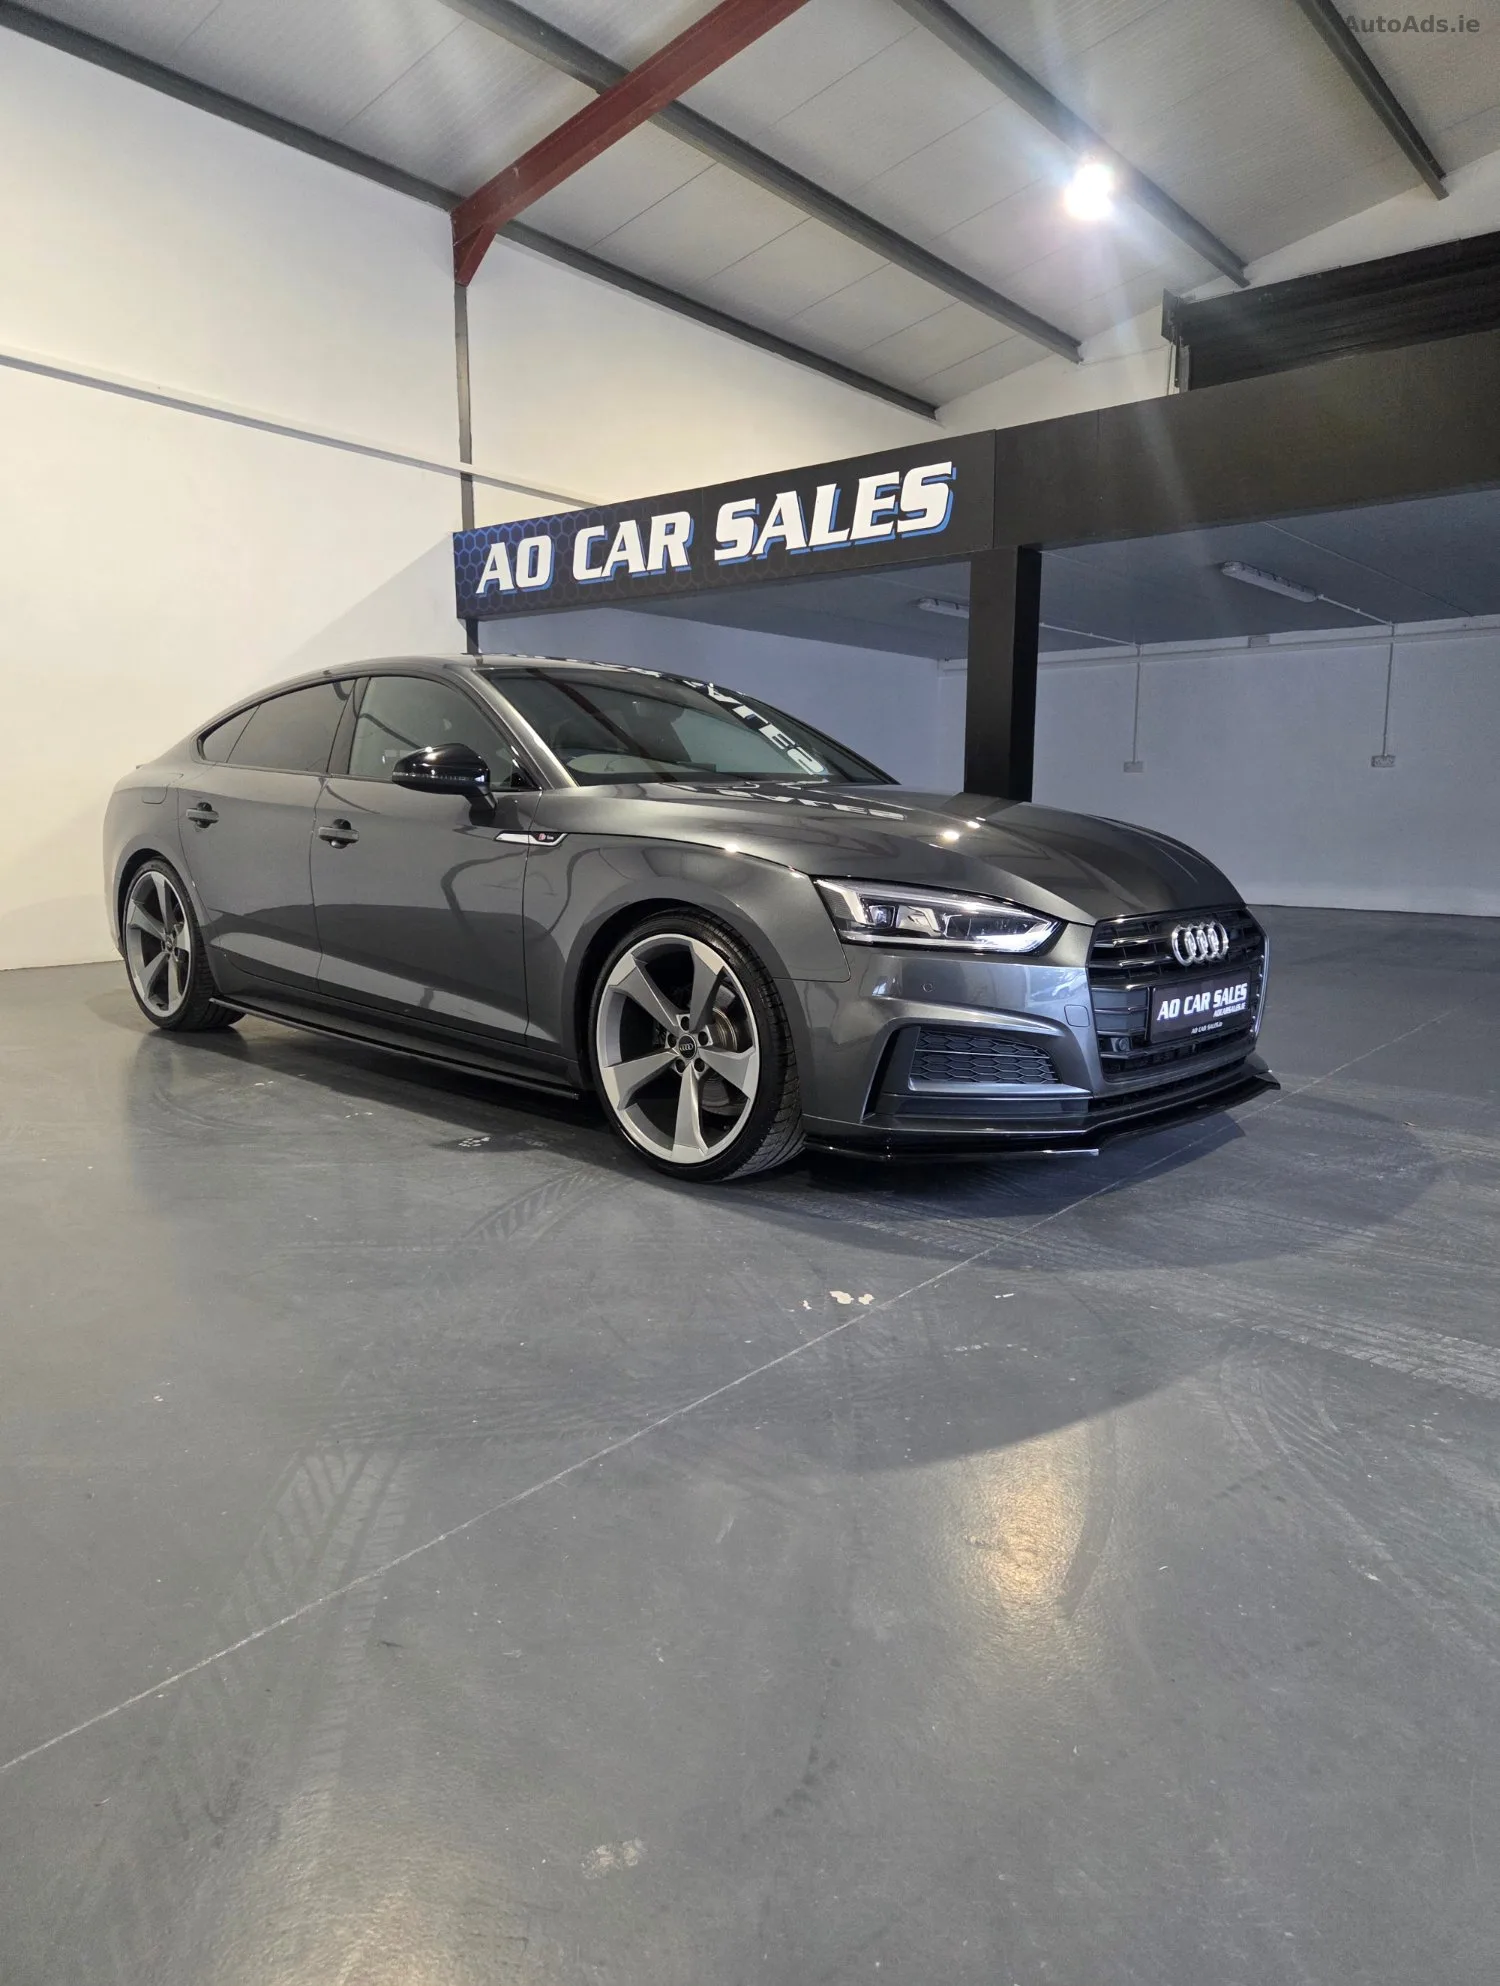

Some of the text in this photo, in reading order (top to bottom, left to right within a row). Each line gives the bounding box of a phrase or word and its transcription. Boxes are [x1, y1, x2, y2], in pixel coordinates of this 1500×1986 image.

[476, 461, 957, 598] AO CAR SALES
[1157, 983, 1248, 1020] AO CAR SALES
